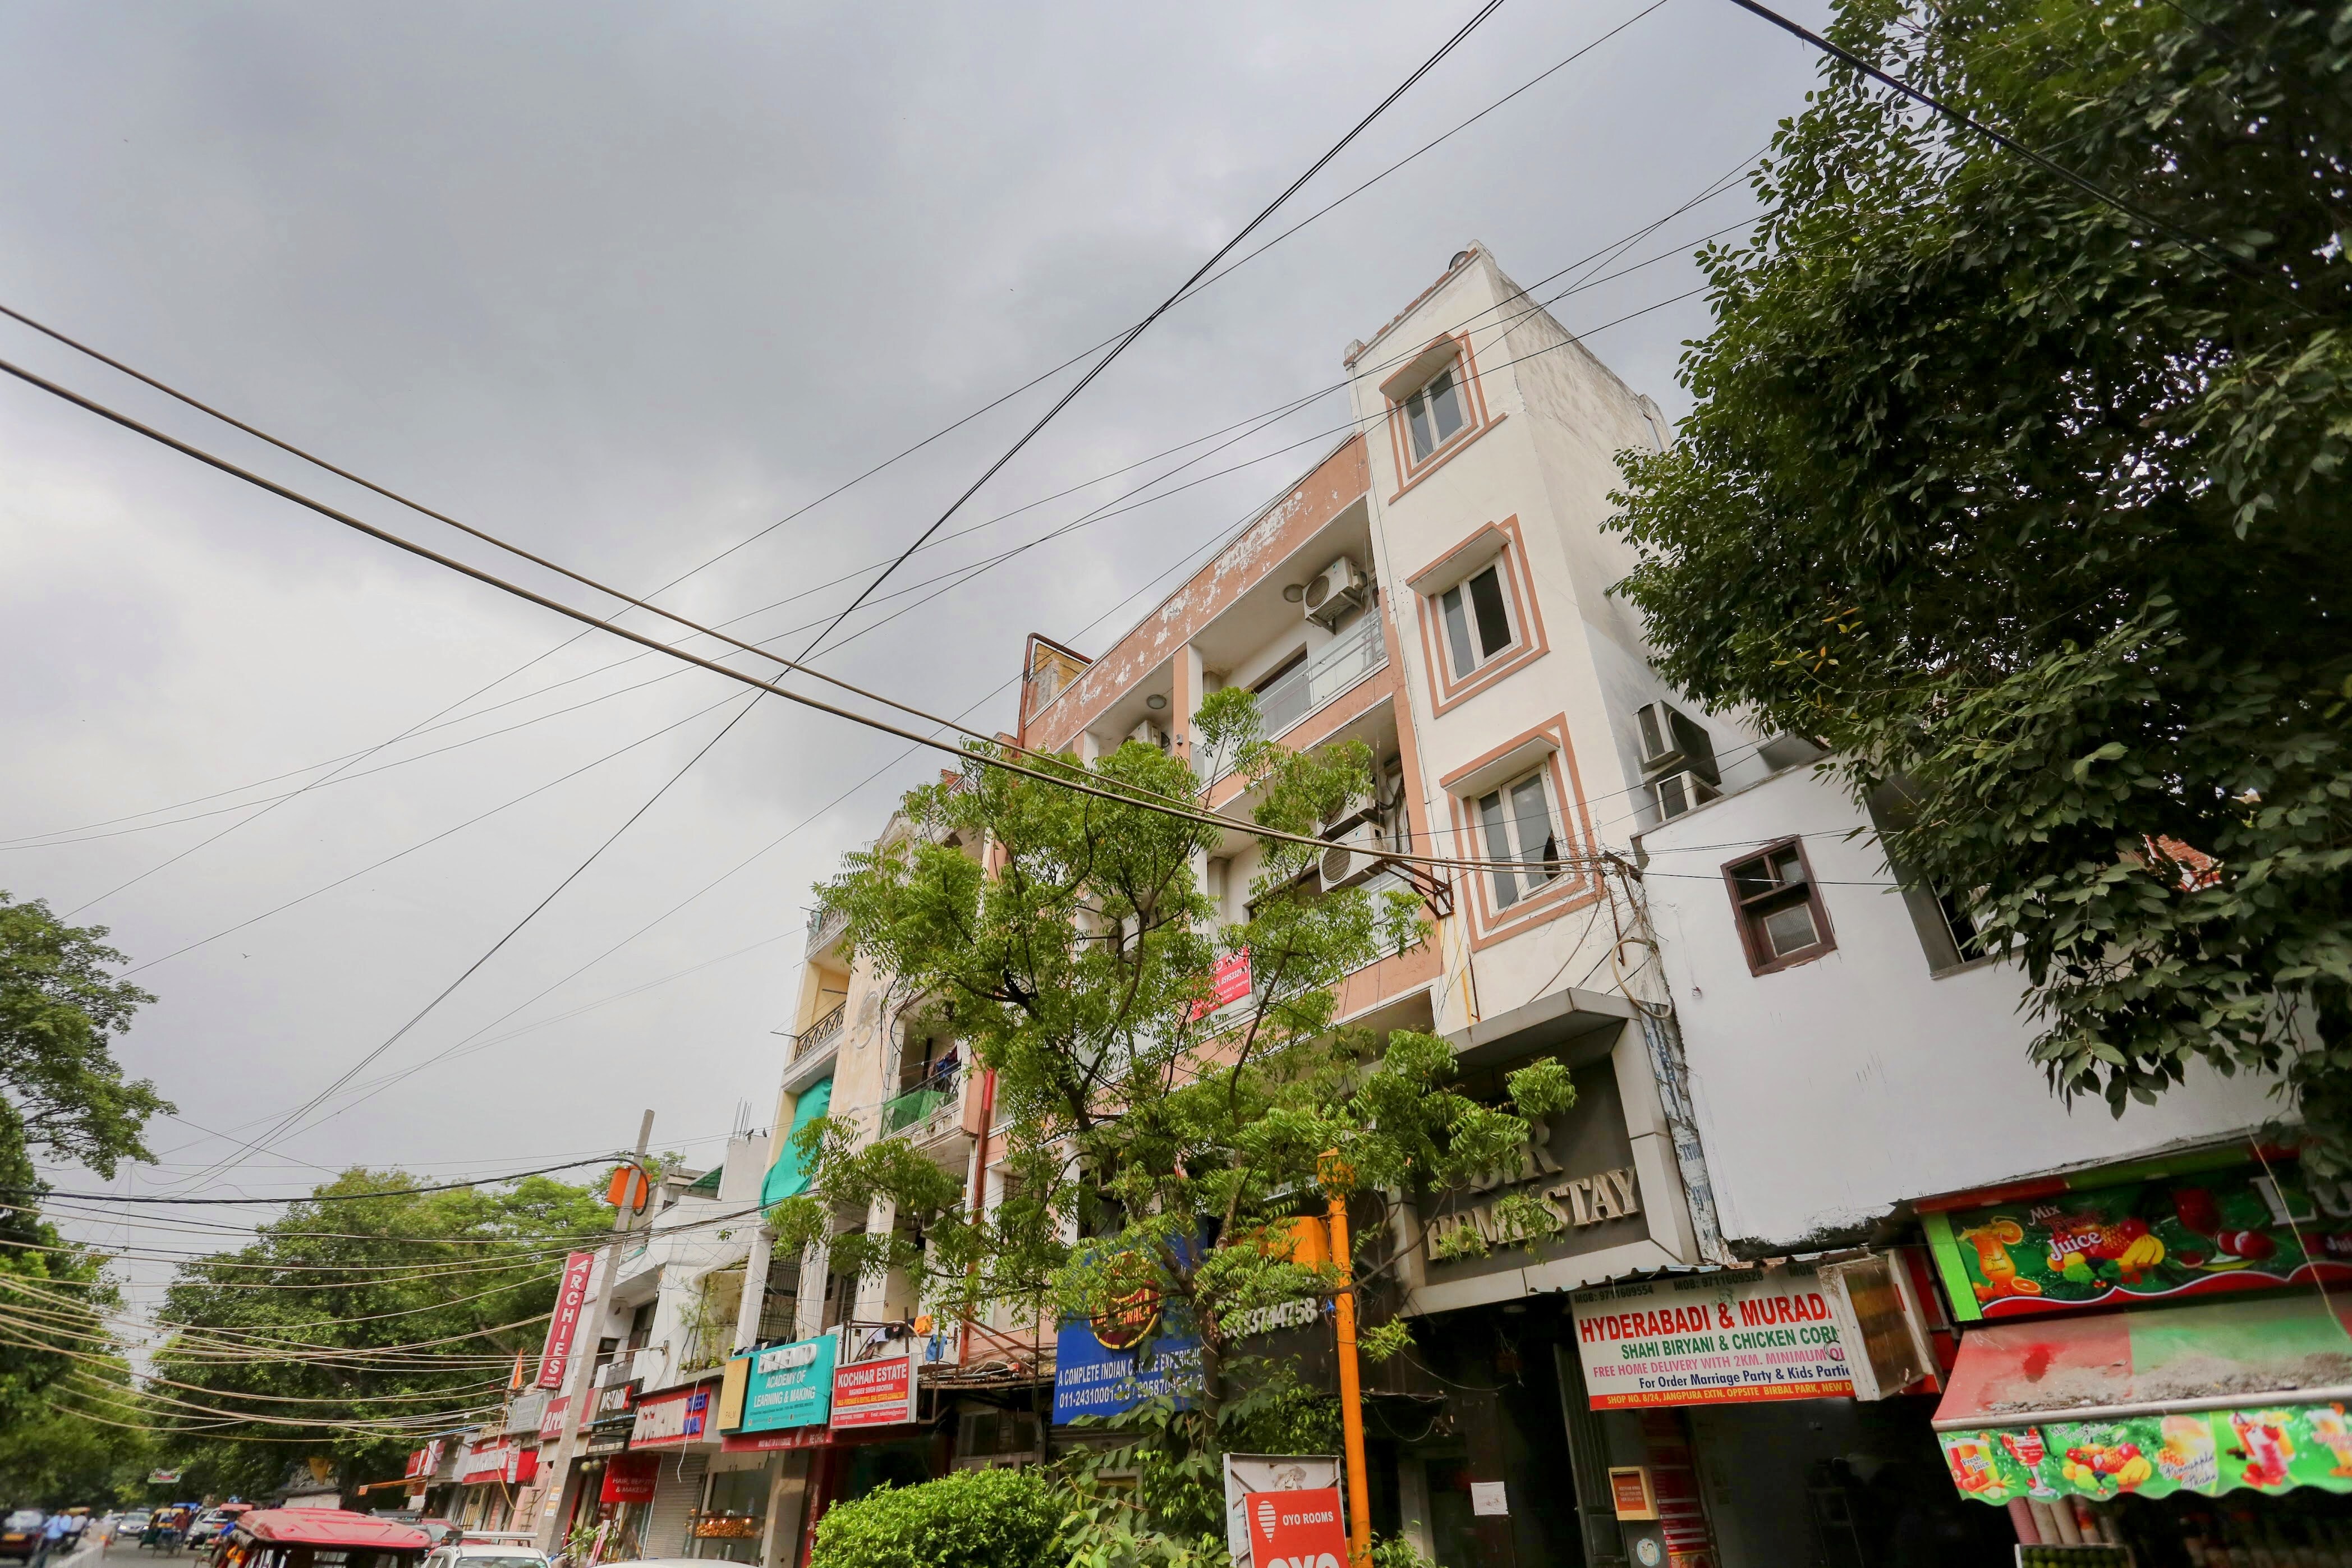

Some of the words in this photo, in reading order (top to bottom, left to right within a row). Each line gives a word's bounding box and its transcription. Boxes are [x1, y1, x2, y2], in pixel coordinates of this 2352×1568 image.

[1541, 1166, 1640, 1232] STAY
[2028, 1205, 2061, 1226] Mix
[2048, 1231, 2102, 1261] Juice
[1574, 1291, 1598, 1304] MOB:
[1599, 1284, 1654, 1301] 9711609554
[1673, 1277, 1700, 1291] MOB:
[1702, 1270, 1764, 1288] 9711609528
[548, 1259, 589, 1375] ARCHIES
[1579, 1305, 1711, 1343] HYDERABADI
[1717, 1302, 1735, 1329] &
[1739, 1293, 1832, 1327] MURAD
[1621, 1341, 1660, 1359] SHAHI
[1662, 1336, 1715, 1356] BIRYANI
[1719, 1335, 1729, 1351] &
[1732, 1329, 1798, 1350] CHICKEN
[838, 1369, 875, 1388] KOCHHAR
[876, 1363, 907, 1382] ESTATE
[1058, 1370, 1063, 1387] A
[1064, 1363, 1100, 1386] COMPLETE
[1101, 1359, 1127, 1381] INDIAN
[1593, 1365, 1616, 1378] FREE
[1618, 1363, 1648, 1376] HOME
[1650, 1359, 1698, 1373] DELIVERY
[1700, 1356, 1731, 1369] WITH
[1734, 1354, 1763, 1367] 2KM.
[1766, 1349, 1827, 1364] MINIMUM
[765, 1373, 796, 1389] ACADEMY
[796, 1369, 807, 1383] OF
[1639, 1377, 1655, 1389] For
[1658, 1374, 1687, 1387] Order
[1690, 1373, 1740, 1386] Marriage
[1743, 1370, 1772, 1383] Party
[1776, 1368, 1785, 1380] &
[1787, 1365, 1813, 1379] Kids
[753, 1391, 783, 1408] LEARNING
[783, 1391, 789, 1403] &
[789, 1386, 816, 1402] MAKING
[1607, 1395, 1626, 1405] SHOP
[1628, 1395, 1642, 1403] NO.
[1643, 1393, 1662, 1403] 8/24,
[1663, 1390, 1702, 1401] JANGPURA
[1704, 1388, 1726, 1399] EXTN.
[1727, 1387, 1760, 1397] OPPSITE
[1763, 1385, 1794, 1395] BIRBAL
[1795, 1383, 1821, 1394] PARK,
[1821, 1382, 1843, 1392] NEW
[1961, 1455, 1981, 1466] Fresh
[1972, 1460, 1991, 1473] Juice
[1282, 1514, 1301, 1526] OYO
[1303, 1511, 1334, 1524] ROOMS
